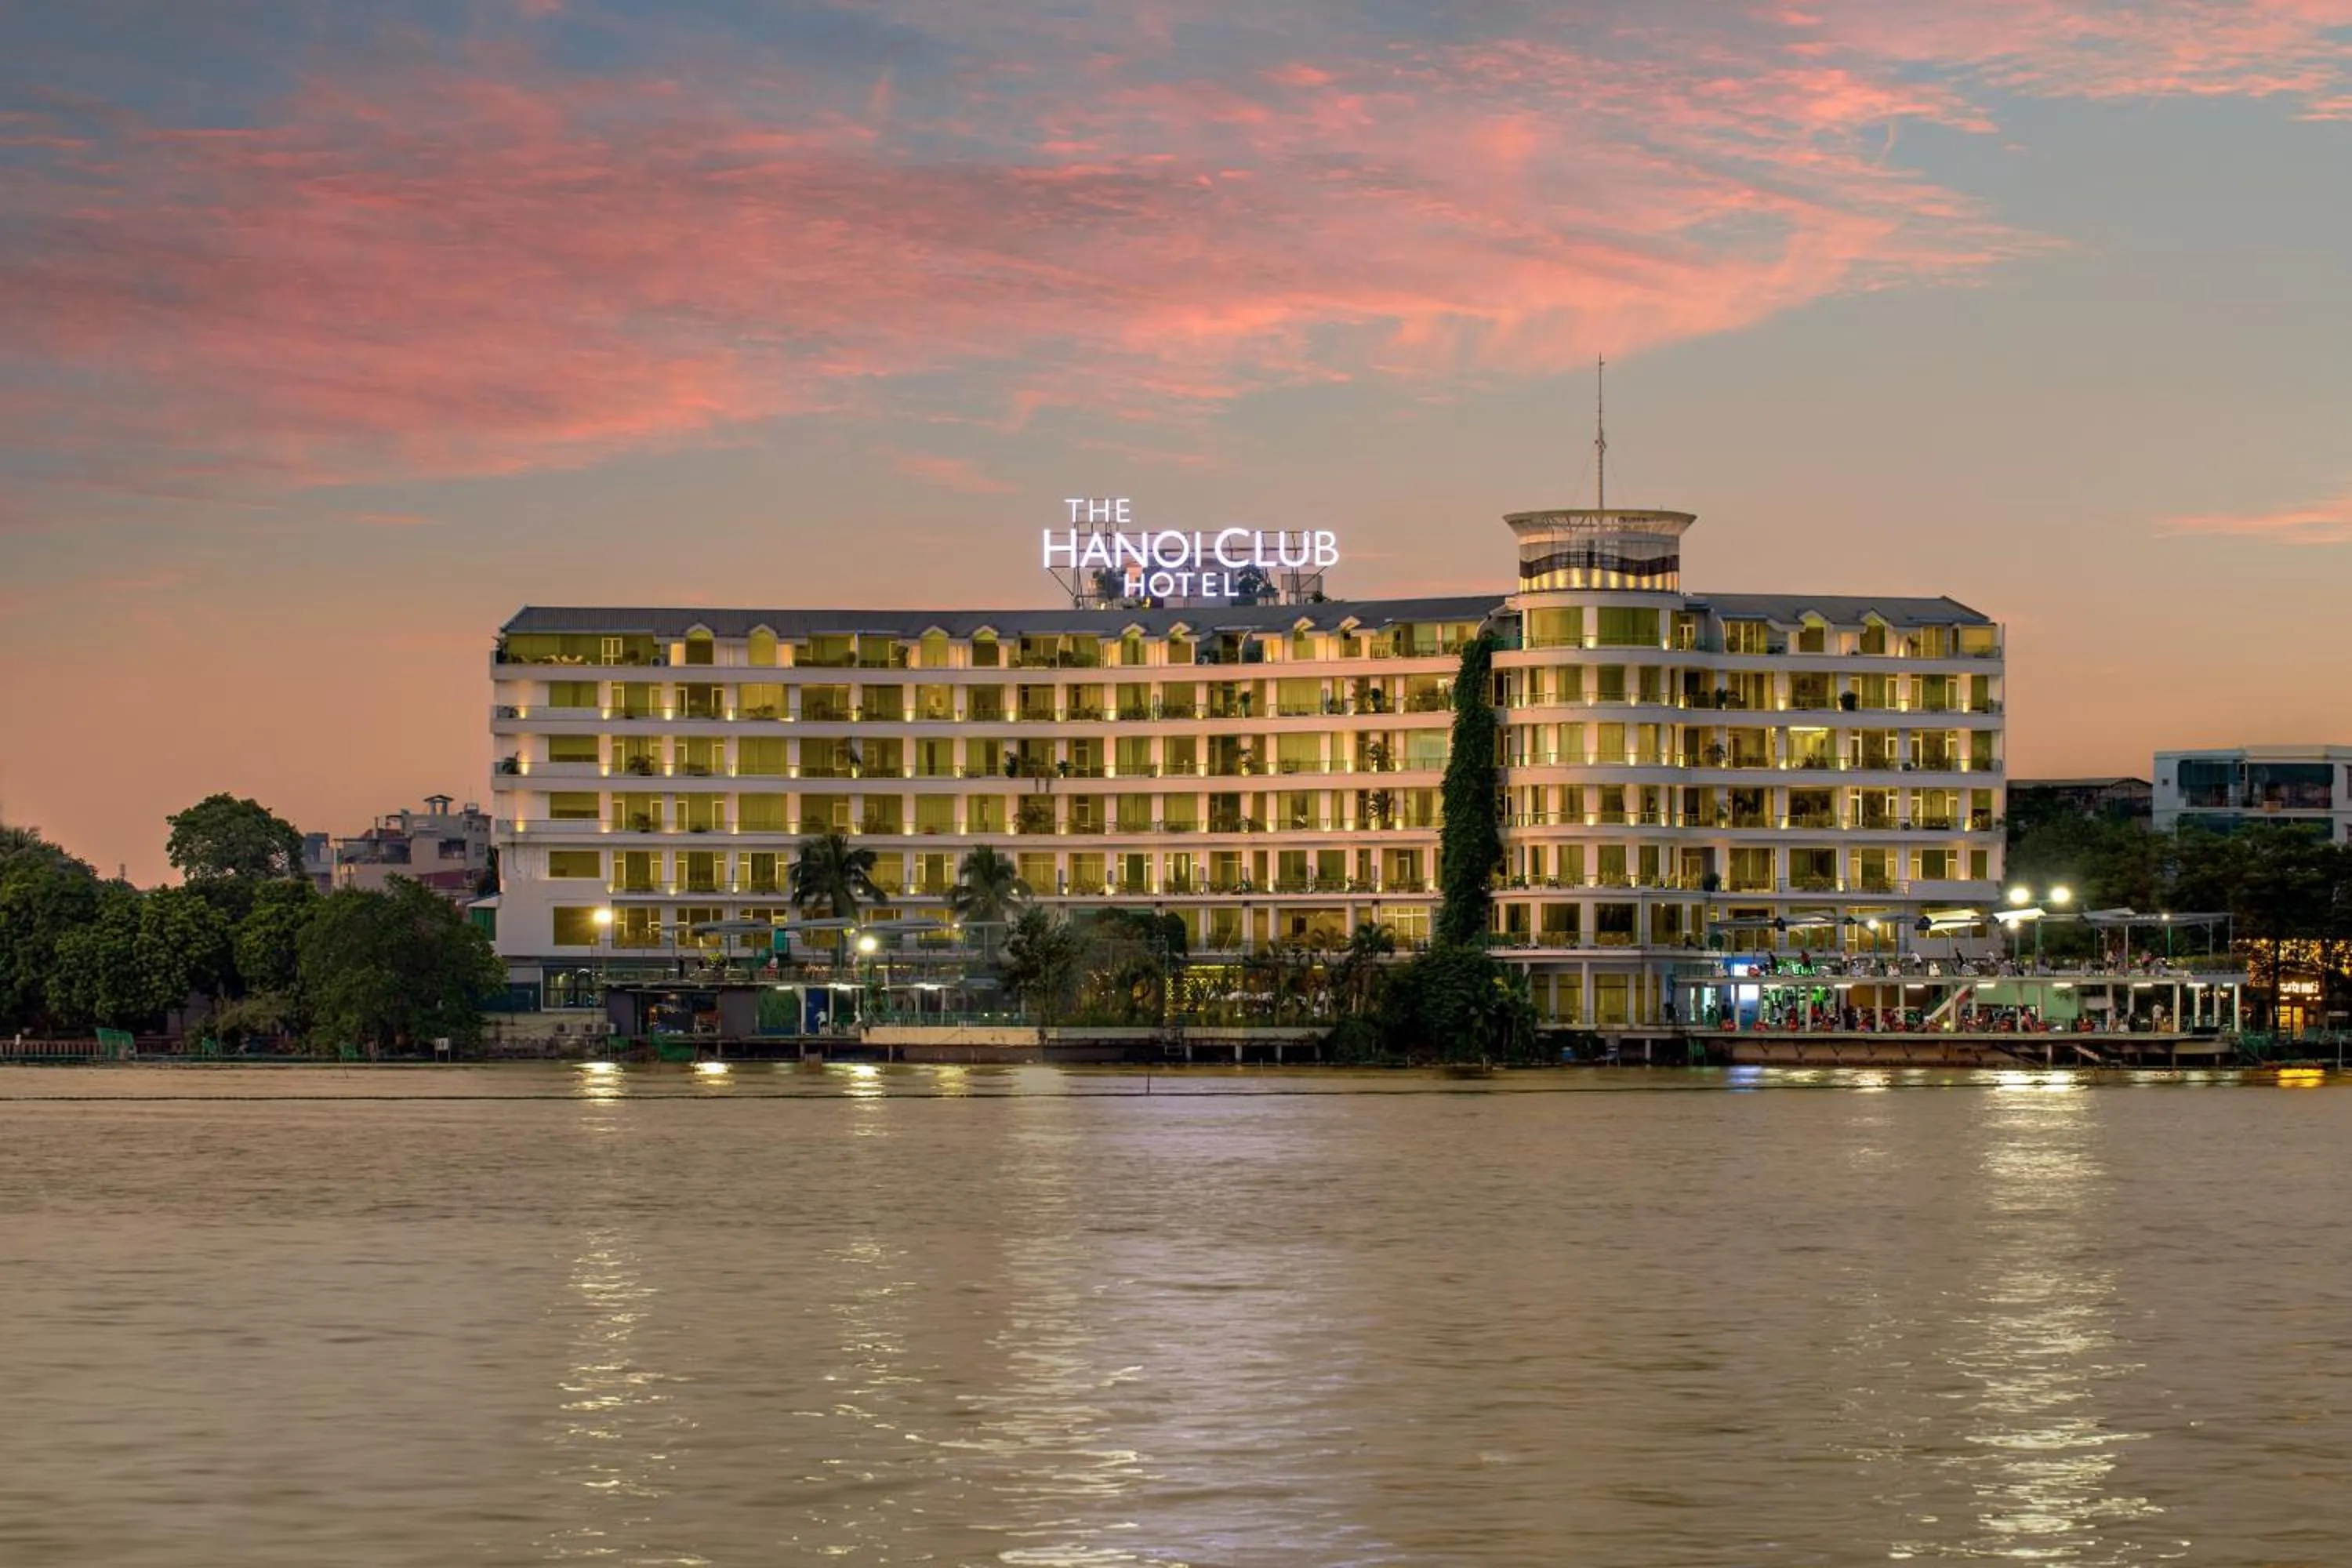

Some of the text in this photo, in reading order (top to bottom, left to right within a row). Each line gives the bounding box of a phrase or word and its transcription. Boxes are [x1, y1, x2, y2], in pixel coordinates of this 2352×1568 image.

[1065, 498, 1131, 523] THE
[1043, 527, 1340, 569] HANOI CLUB
[1123, 572, 1240, 597] HOTEL
